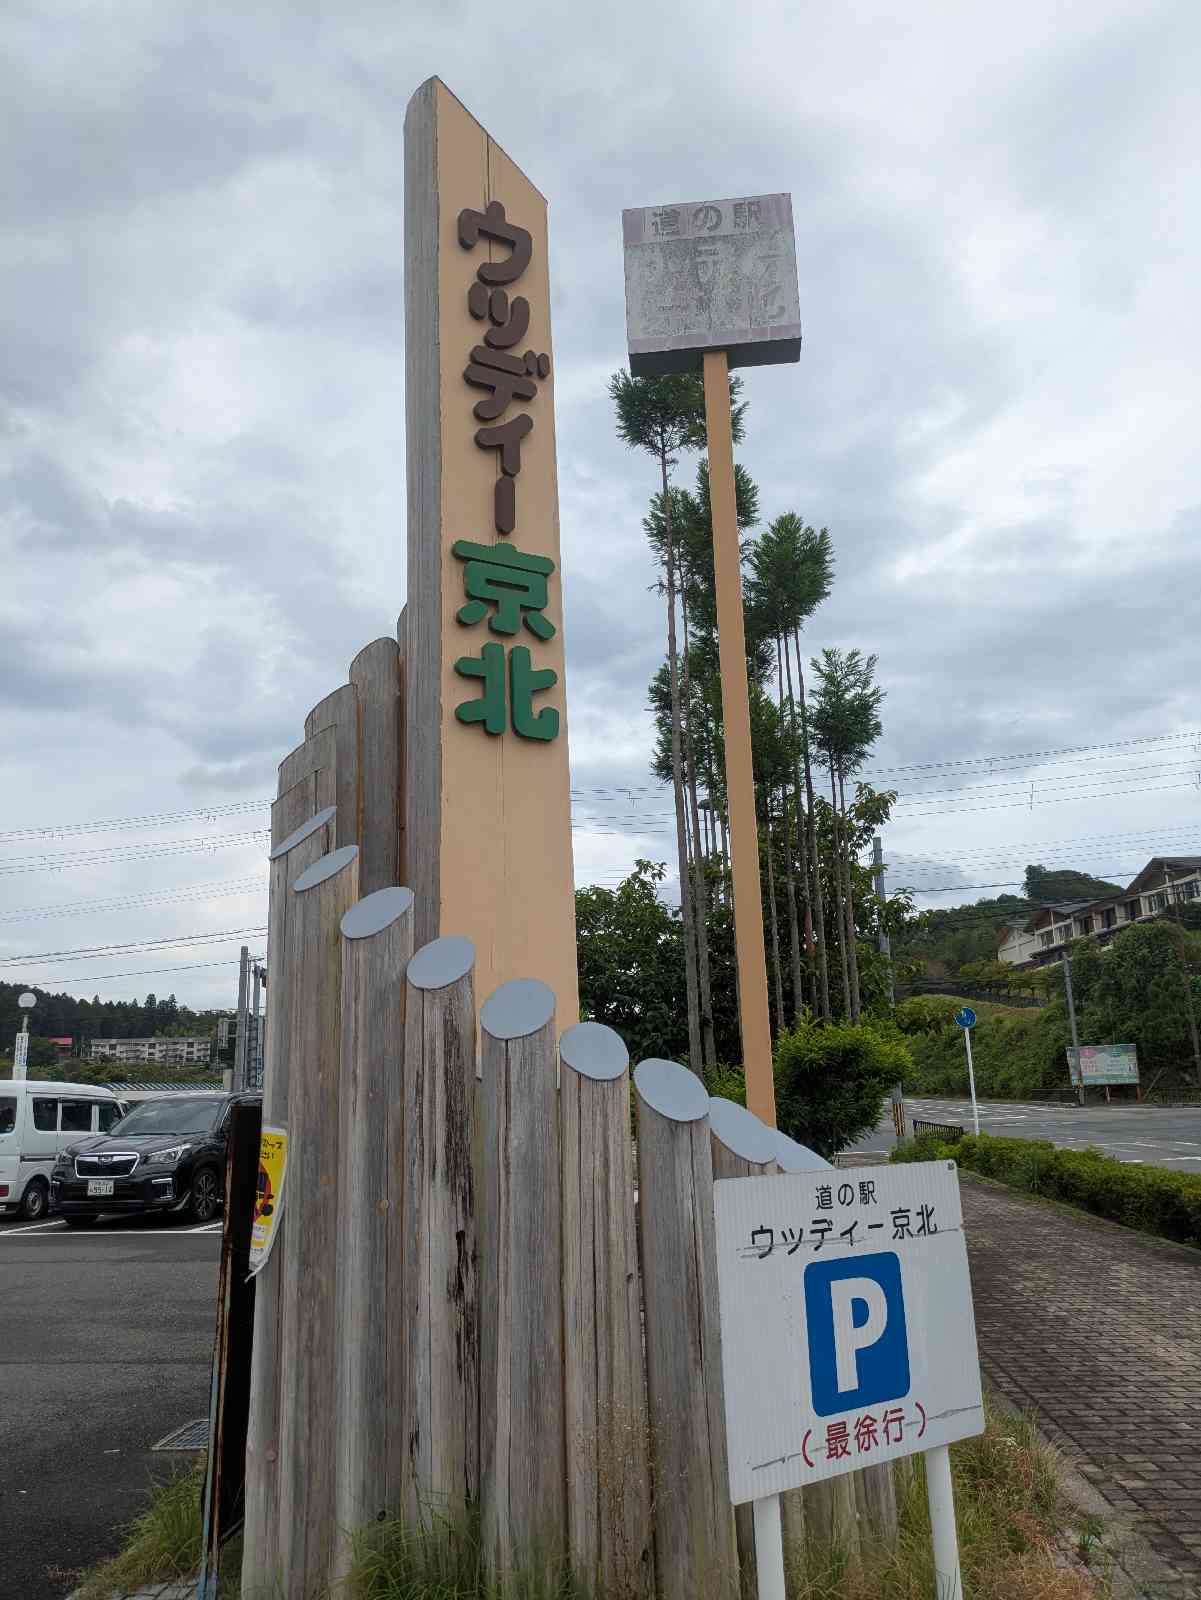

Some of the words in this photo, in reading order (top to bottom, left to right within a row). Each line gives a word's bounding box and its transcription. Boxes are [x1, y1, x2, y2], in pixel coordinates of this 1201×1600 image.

[652, 200, 761, 236] 道の駅
[815, 1180, 878, 1210] 道の駅
[831, 1277, 888, 1393] P
